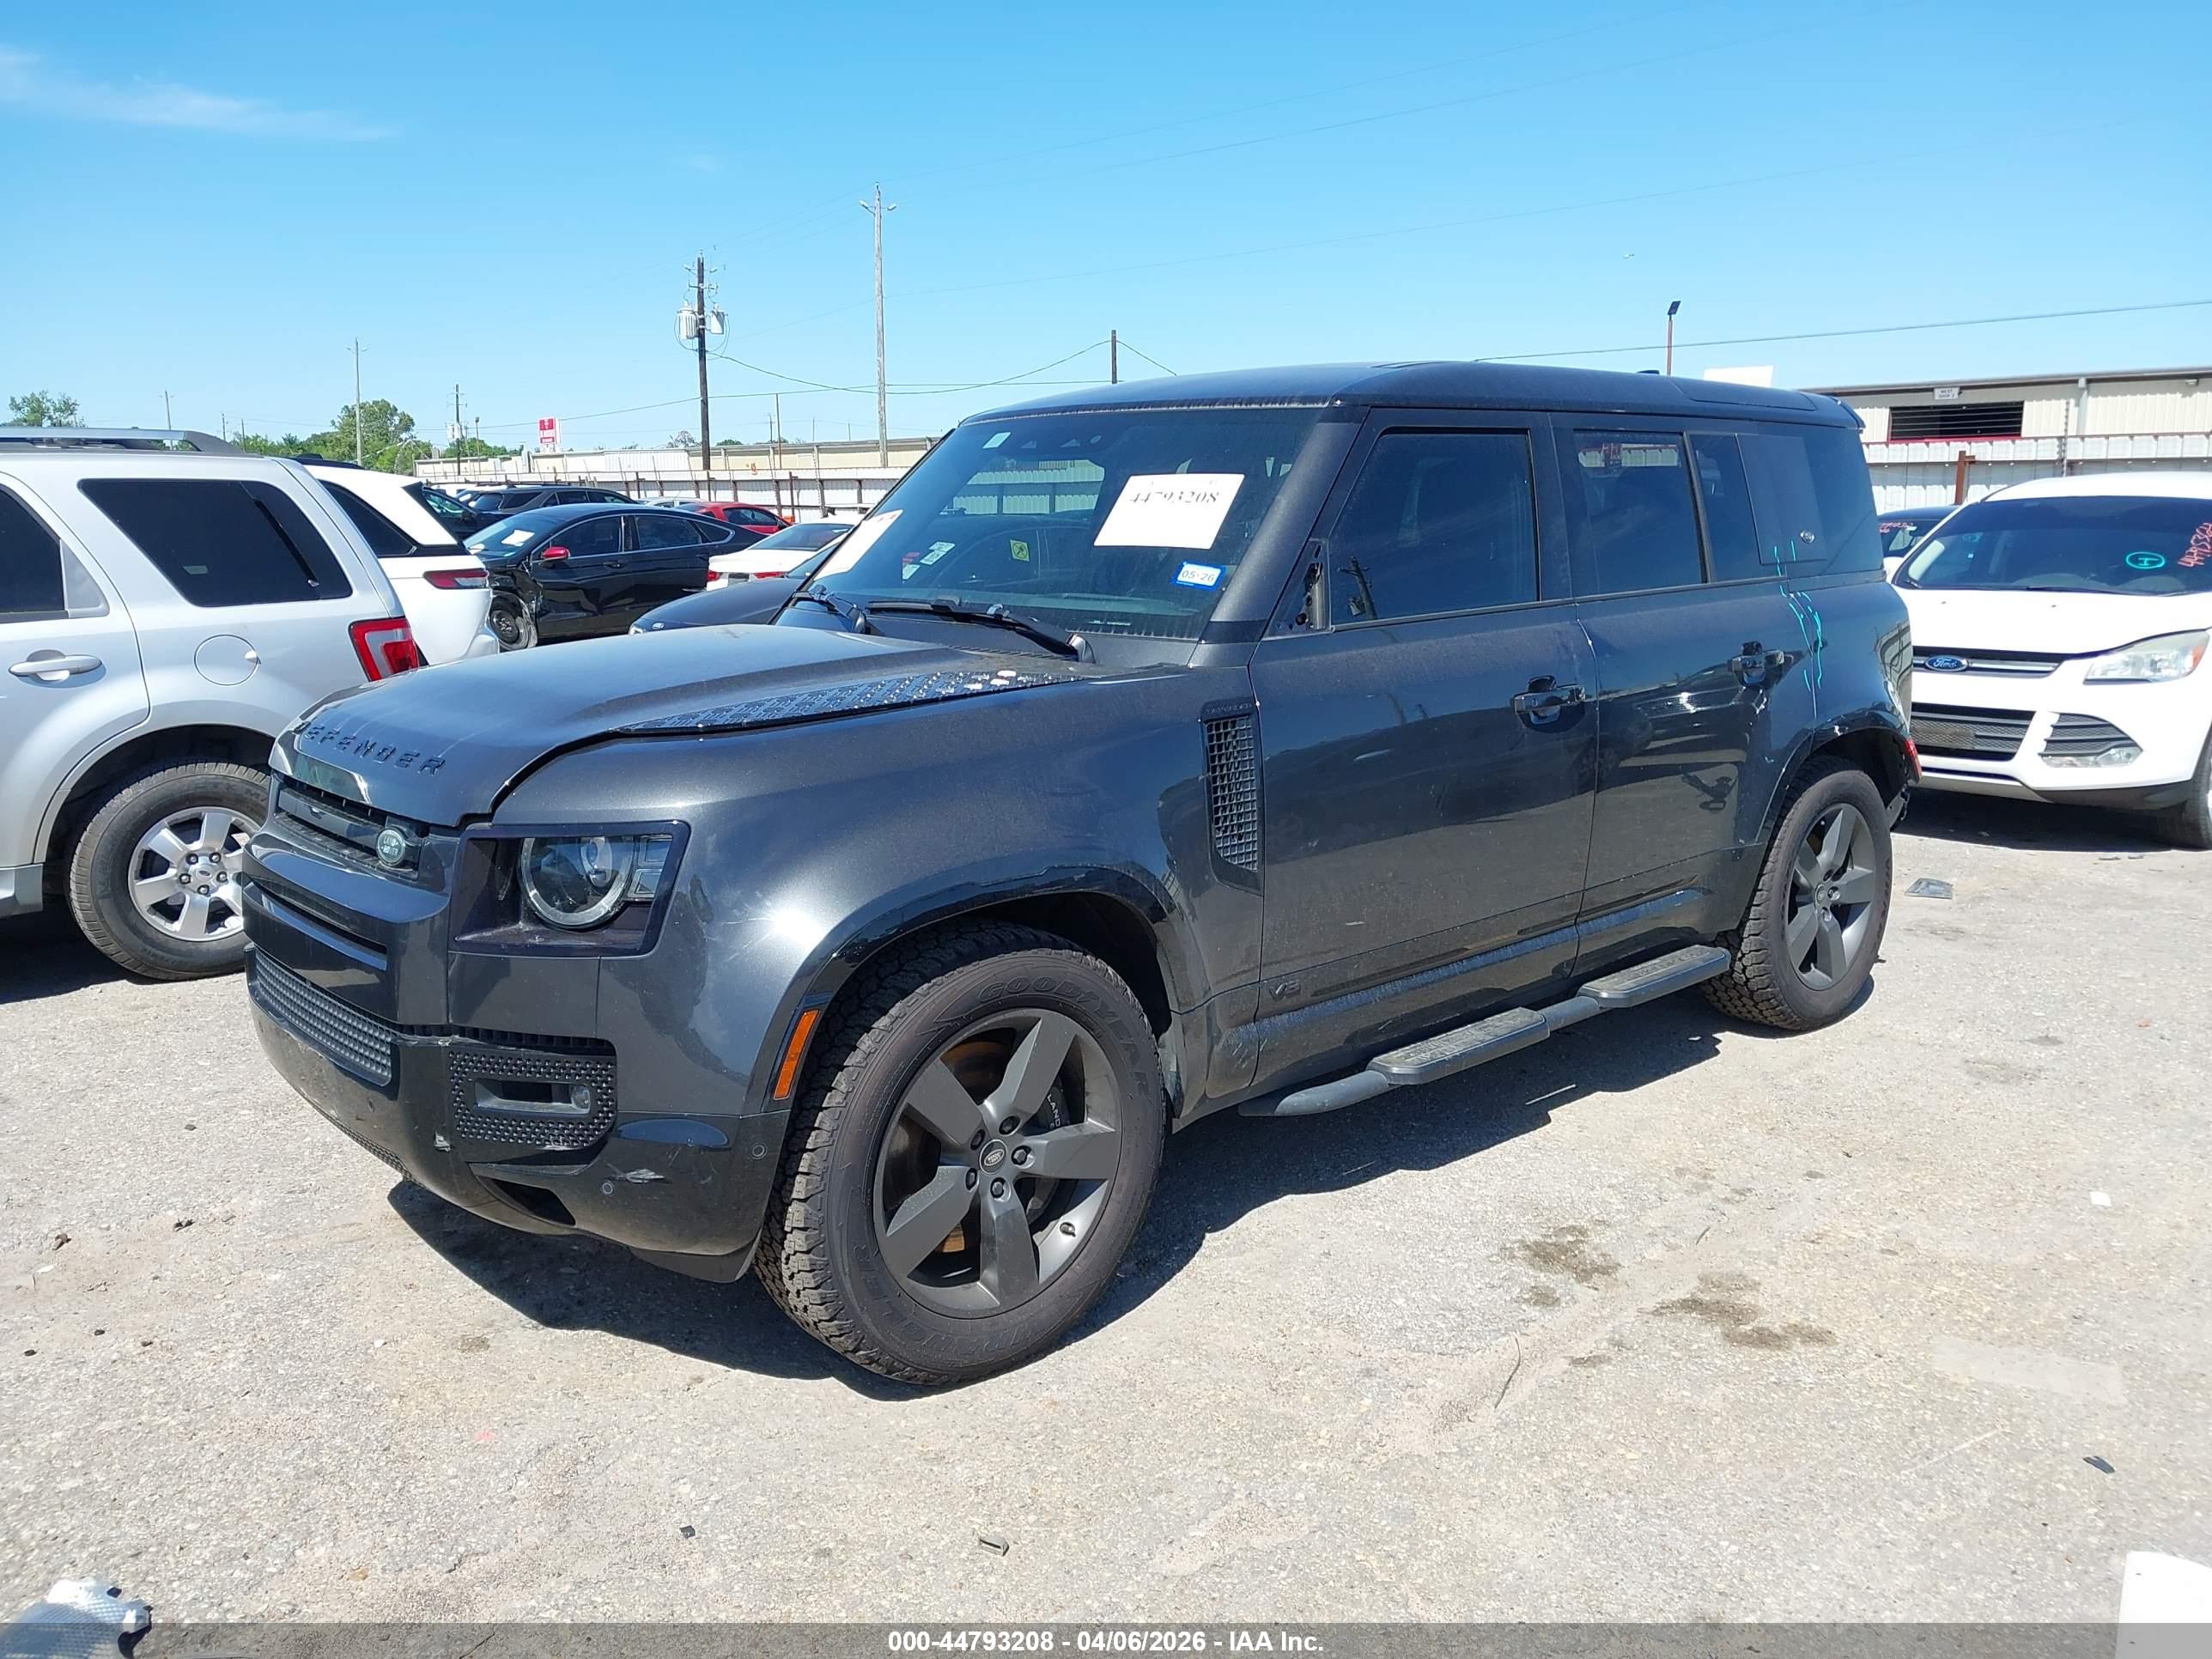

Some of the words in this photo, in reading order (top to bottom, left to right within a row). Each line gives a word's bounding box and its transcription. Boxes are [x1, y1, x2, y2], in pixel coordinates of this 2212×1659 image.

[1933, 657, 1958, 668] Ford
[293, 720, 446, 776] DEFENDER
[976, 975, 1152, 1095] GOODYEAR
[1047, 1093, 1061, 1127] LAND
